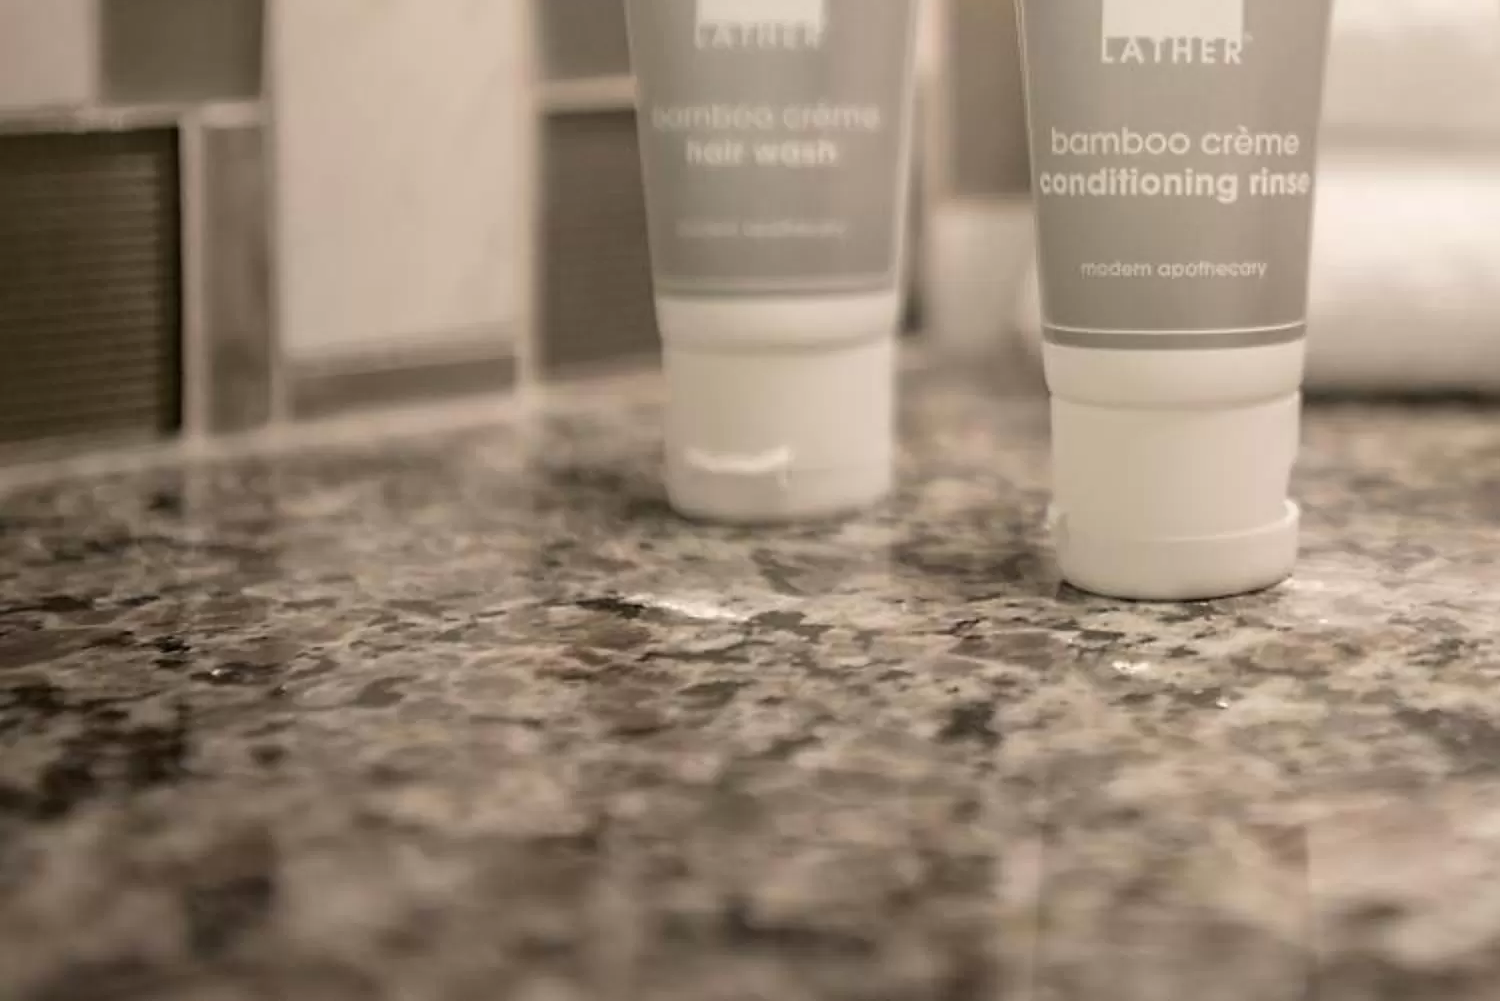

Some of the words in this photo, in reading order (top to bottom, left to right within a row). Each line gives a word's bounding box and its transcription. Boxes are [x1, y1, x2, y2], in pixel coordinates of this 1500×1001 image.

[1101, 36, 1243, 64] LATHER
[1051, 127, 1190, 155] bamboo
[1201, 125, 1300, 155] crème
[1040, 167, 1239, 204] conditioning
[1249, 167, 1312, 196] rinse
[1081, 260, 1152, 277] modern
[1158, 260, 1267, 280] apothecary
